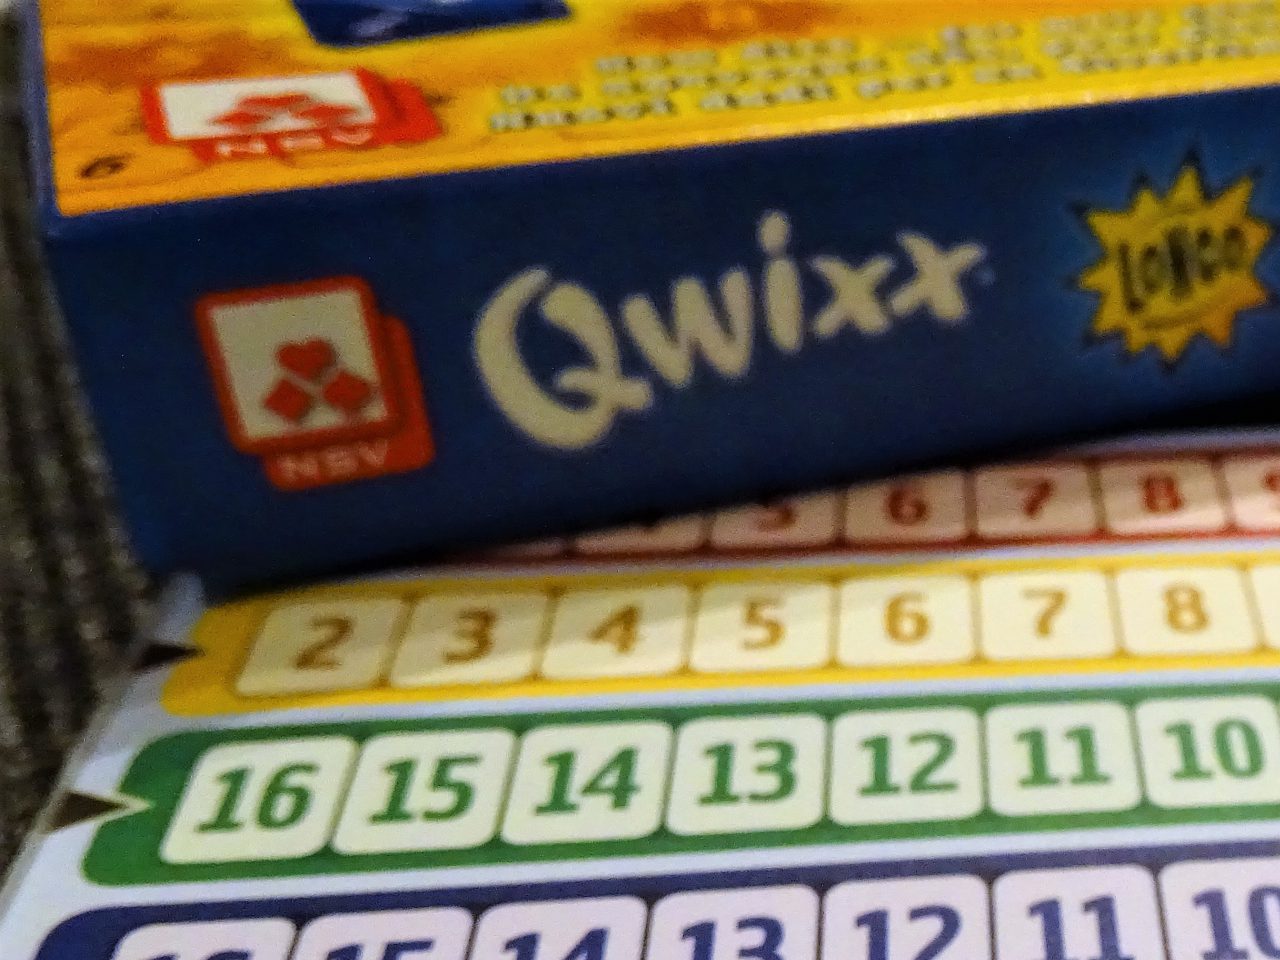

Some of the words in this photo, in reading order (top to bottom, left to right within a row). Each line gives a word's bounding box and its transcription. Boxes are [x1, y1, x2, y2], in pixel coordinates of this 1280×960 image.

[474, 211, 984, 449] Qwixx
[278, 439, 389, 482] NSV
[884, 472, 927, 526] 6
[1018, 477, 1055, 519] 7
[1138, 472, 1183, 513] 8
[297, 615, 353, 669] 2
[446, 610, 494, 662] 3
[590, 604, 641, 655] 4
[742, 599, 786, 650] 5
[884, 592, 930, 644] 6
[1023, 589, 1066, 636] 7
[1164, 585, 1208, 632] 8
[193, 763, 318, 833] 16
[369, 754, 482, 824] 15
[534, 746, 641, 813] 14
[696, 739, 797, 803] 13
[858, 732, 956, 794] 12
[1017, 725, 1109, 787] 11
[1164, 719, 1264, 780] 10
